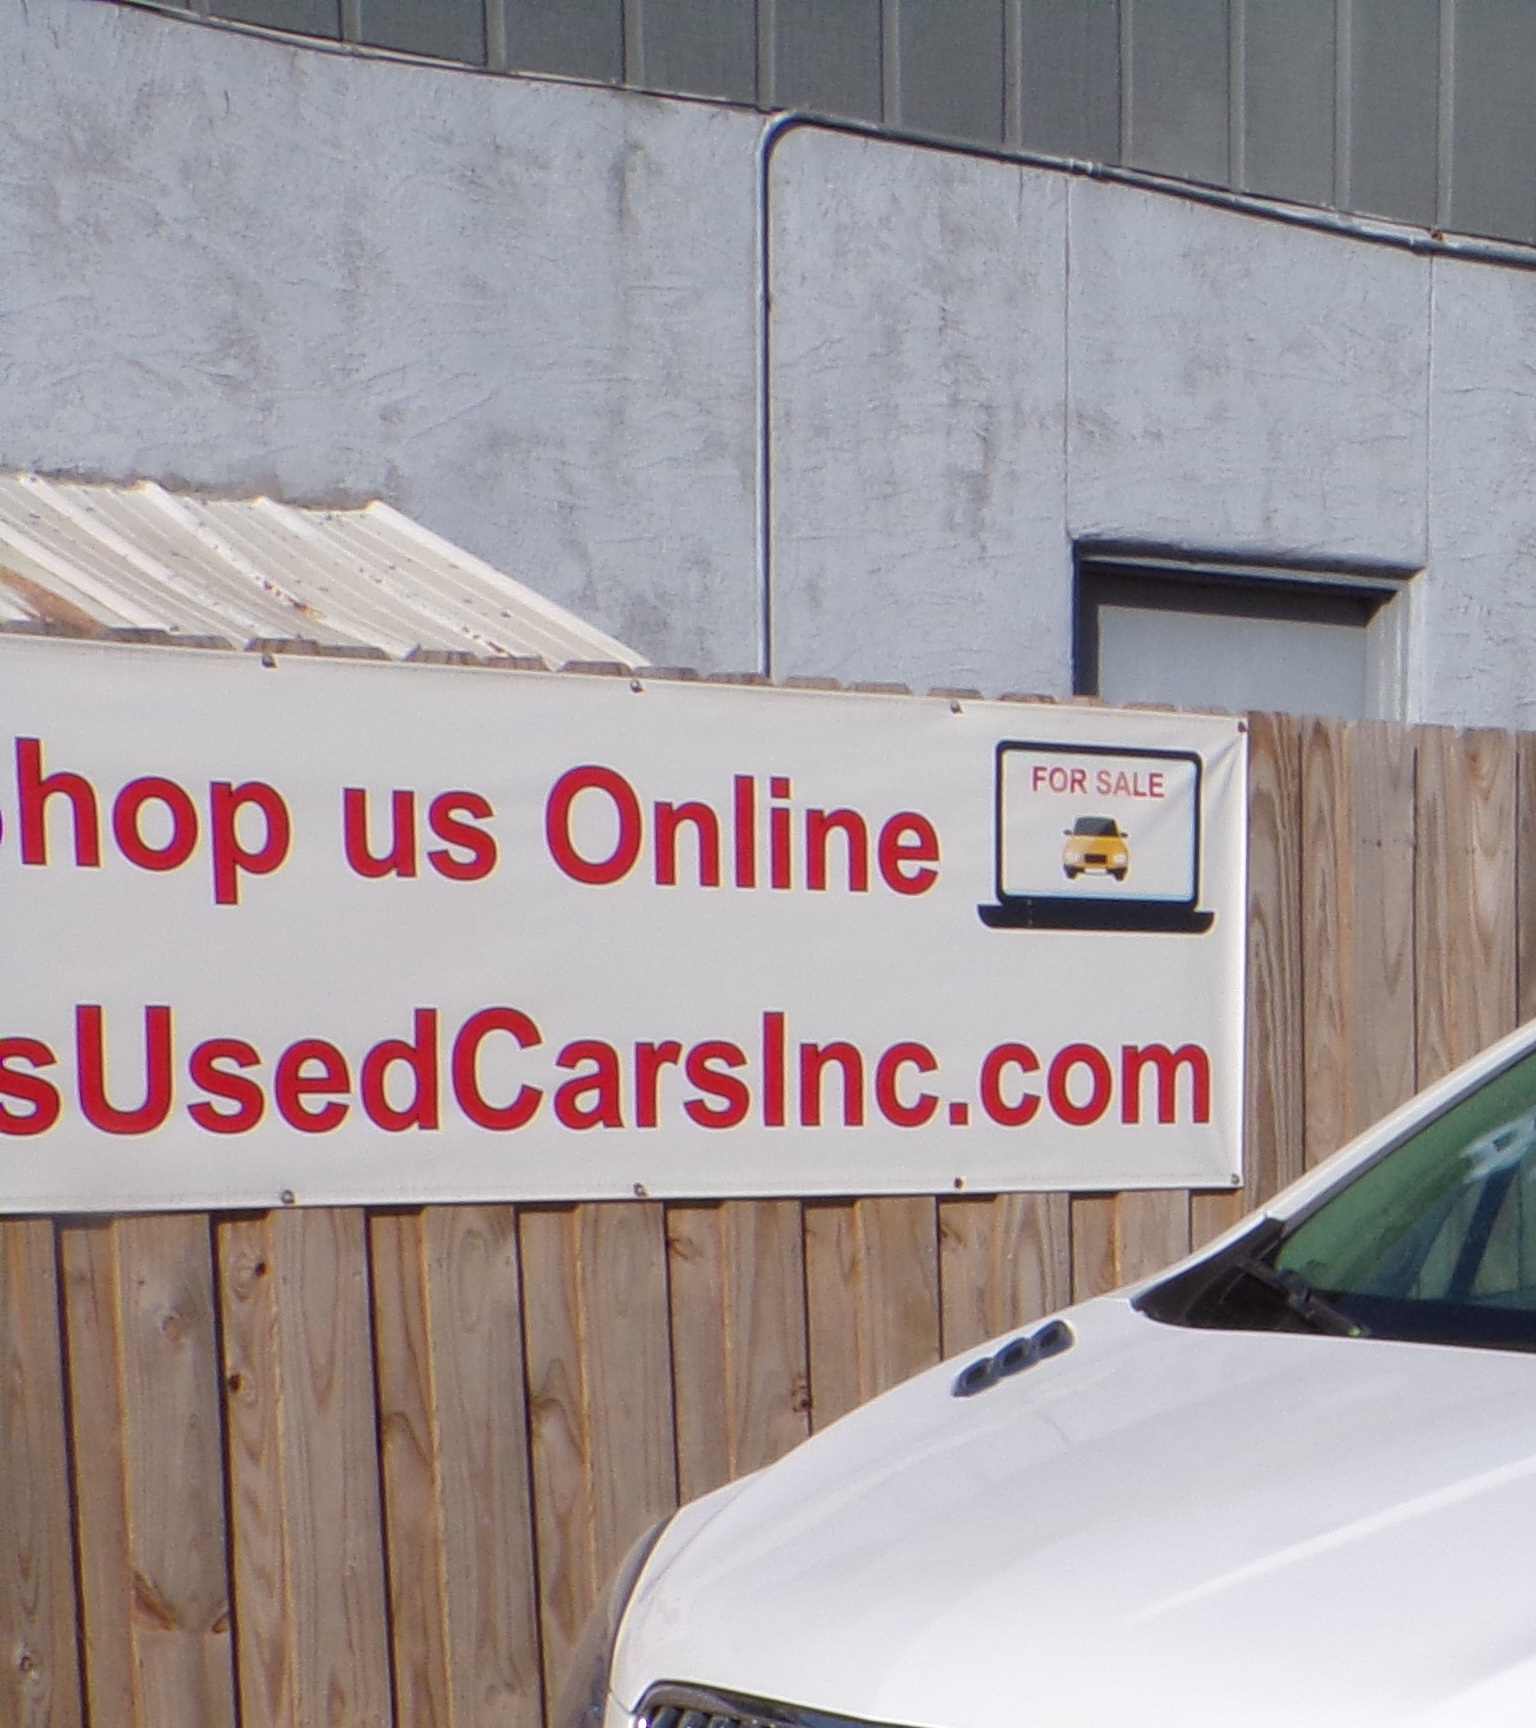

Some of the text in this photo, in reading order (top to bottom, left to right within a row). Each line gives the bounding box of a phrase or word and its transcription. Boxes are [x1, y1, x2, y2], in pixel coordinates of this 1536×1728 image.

[0, 737, 941, 907] hop us Online
[1031, 766, 1165, 798] FOR SALE
